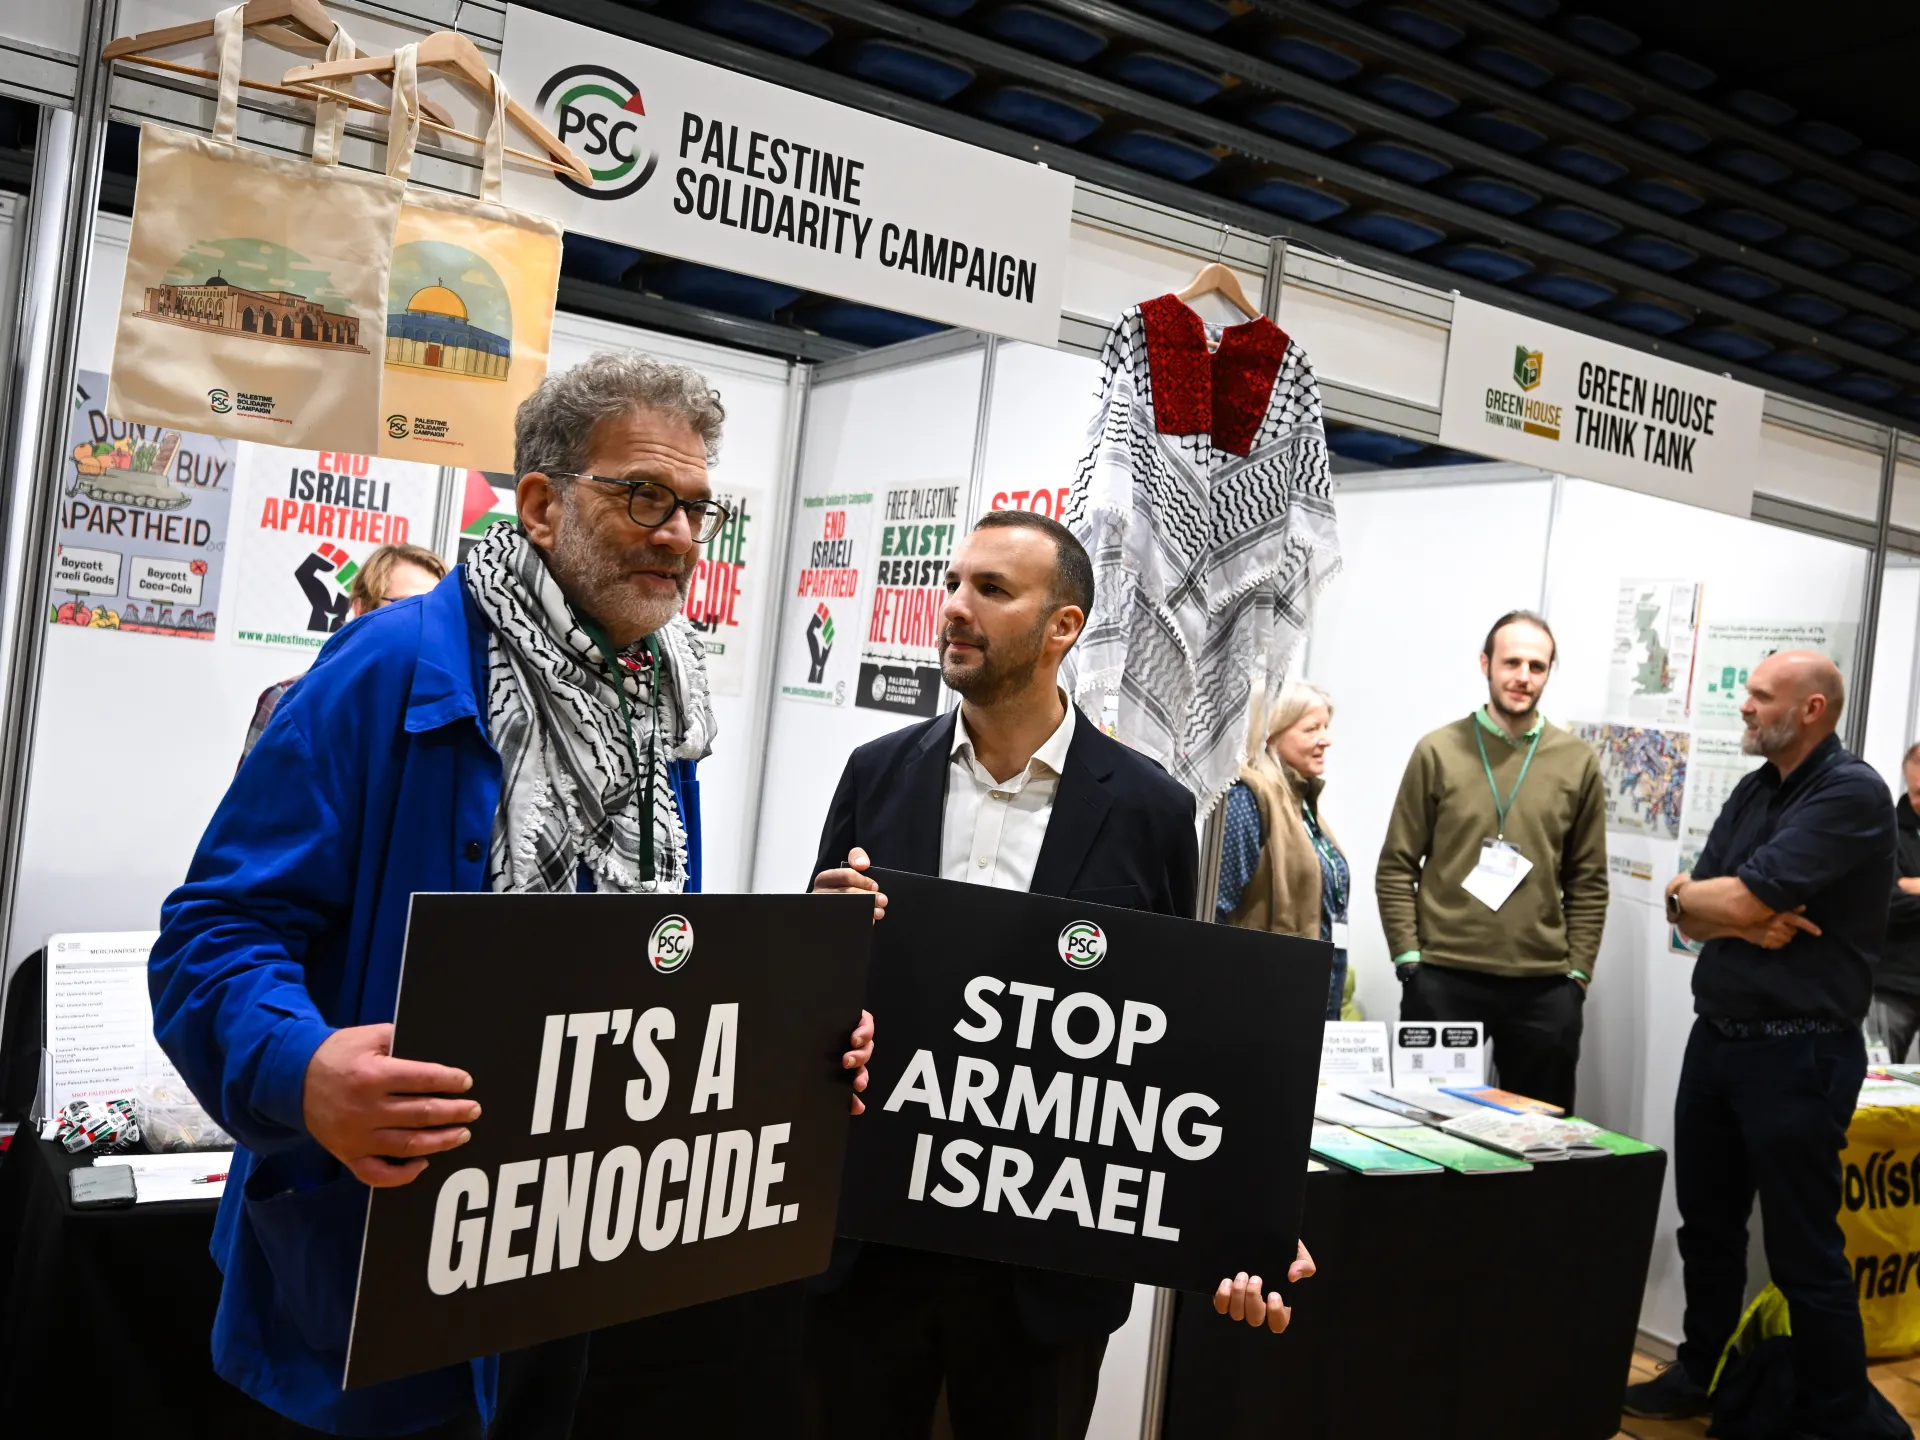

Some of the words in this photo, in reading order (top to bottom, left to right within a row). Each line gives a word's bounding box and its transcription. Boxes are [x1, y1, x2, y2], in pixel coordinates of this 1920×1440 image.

[558, 104, 637, 163] PSC
[680, 112, 864, 206] PALESTINE
[673, 168, 873, 259] SOLIDARITY
[879, 223, 1037, 303] CAMPAIGN
[212, 397, 228, 407] PSC
[237, 393, 272, 402] PALESTINE
[237, 399, 275, 409] SOLIDARITY
[237, 405, 271, 414] CAMPAIGN
[1577, 361, 1647, 416] GREEN
[1651, 383, 1717, 436] HOUSE
[390, 422, 406, 432] PSC
[413, 429, 445, 438] CAMPAIGN
[414, 417, 448, 426] PALESTINE
[414, 423, 450, 432] SOLIDARITY
[1485, 411, 1504, 427] THINK
[1506, 416, 1522, 431] TANK
[1575, 405, 1638, 458] THINK
[1644, 424, 1696, 473] TANK
[175, 450, 228, 487] BUY
[317, 451, 370, 477] END
[289, 468, 391, 512] ISRAELI
[885, 490, 909, 520] FREE
[909, 486, 960, 520] PALESTINE
[991, 487, 1070, 523] STOP
[260, 497, 409, 547] APARTHEID
[824, 511, 846, 540] END
[810, 539, 853, 568] ISRAELI
[881, 524, 955, 557] EXIST!
[61, 556, 103, 571] Boycott
[147, 567, 188, 583] Boycott
[877, 560, 951, 587] RESIST!
[83, 573, 115, 586] Goods
[139, 579, 193, 595] Coca-Cola
[797, 568, 859, 598] APARTHEID
[869, 587, 946, 649] RETURN!
[887, 684, 922, 697] SOLIDARITY
[888, 675, 920, 688] PALESTINE
[885, 693, 917, 705] CAMPAIGN
[657, 935, 686, 956] PSC
[1067, 937, 1098, 955] PSC
[953, 975, 1168, 1066] STOP
[530, 1006, 676, 1135] IT'S
[690, 1002, 739, 1115] A
[883, 1048, 1224, 1161] ARMING
[907, 1133, 1180, 1242] ISRAEL
[426, 1122, 800, 1296] GENOCIDE.
